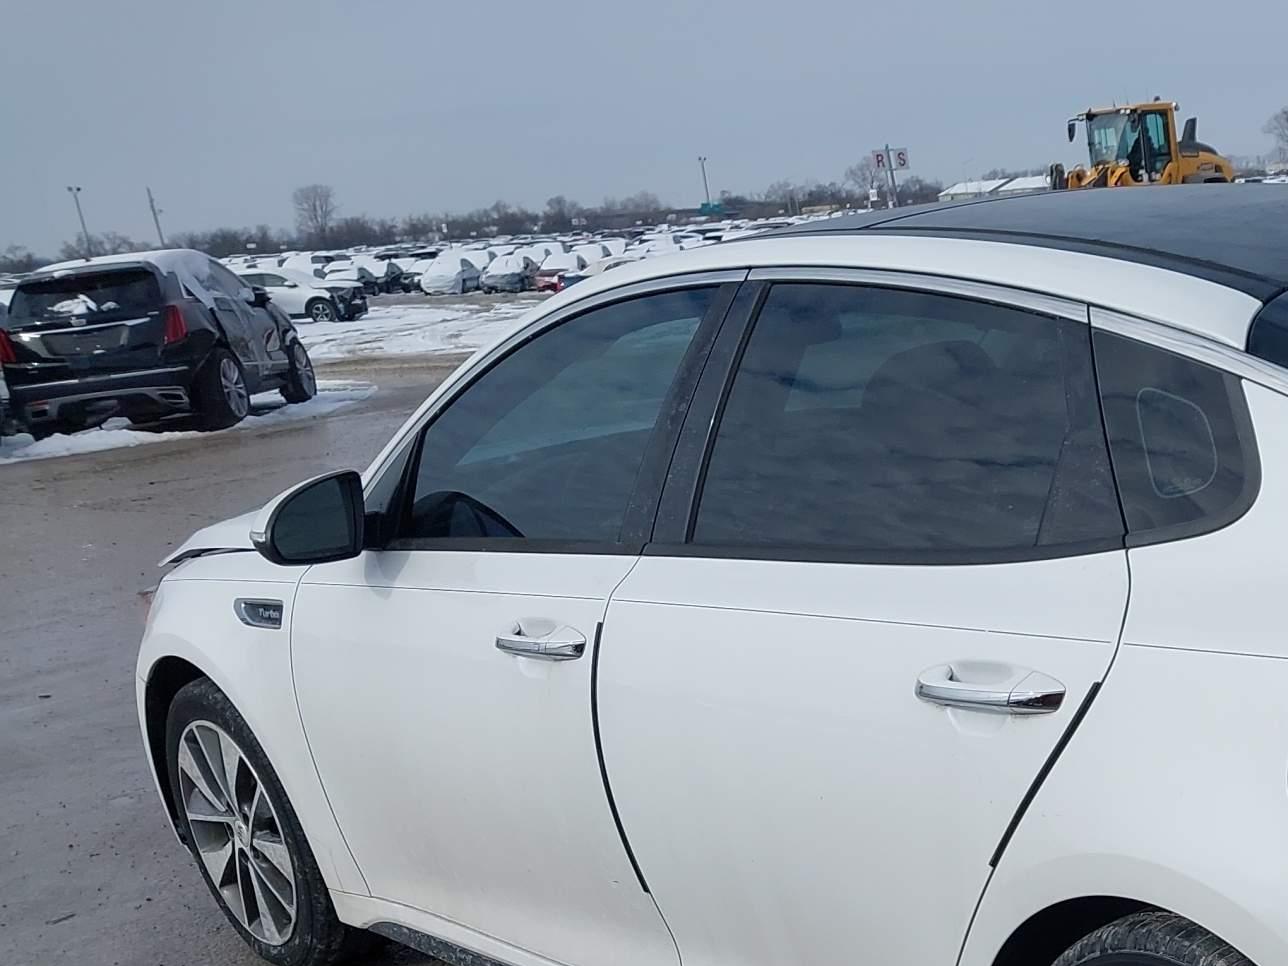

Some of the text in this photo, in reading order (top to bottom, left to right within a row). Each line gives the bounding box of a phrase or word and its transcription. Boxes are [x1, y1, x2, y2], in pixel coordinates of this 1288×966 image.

[876, 153, 885, 168] R
[897, 151, 906, 167] S
[258, 607, 280, 618] Turbo
